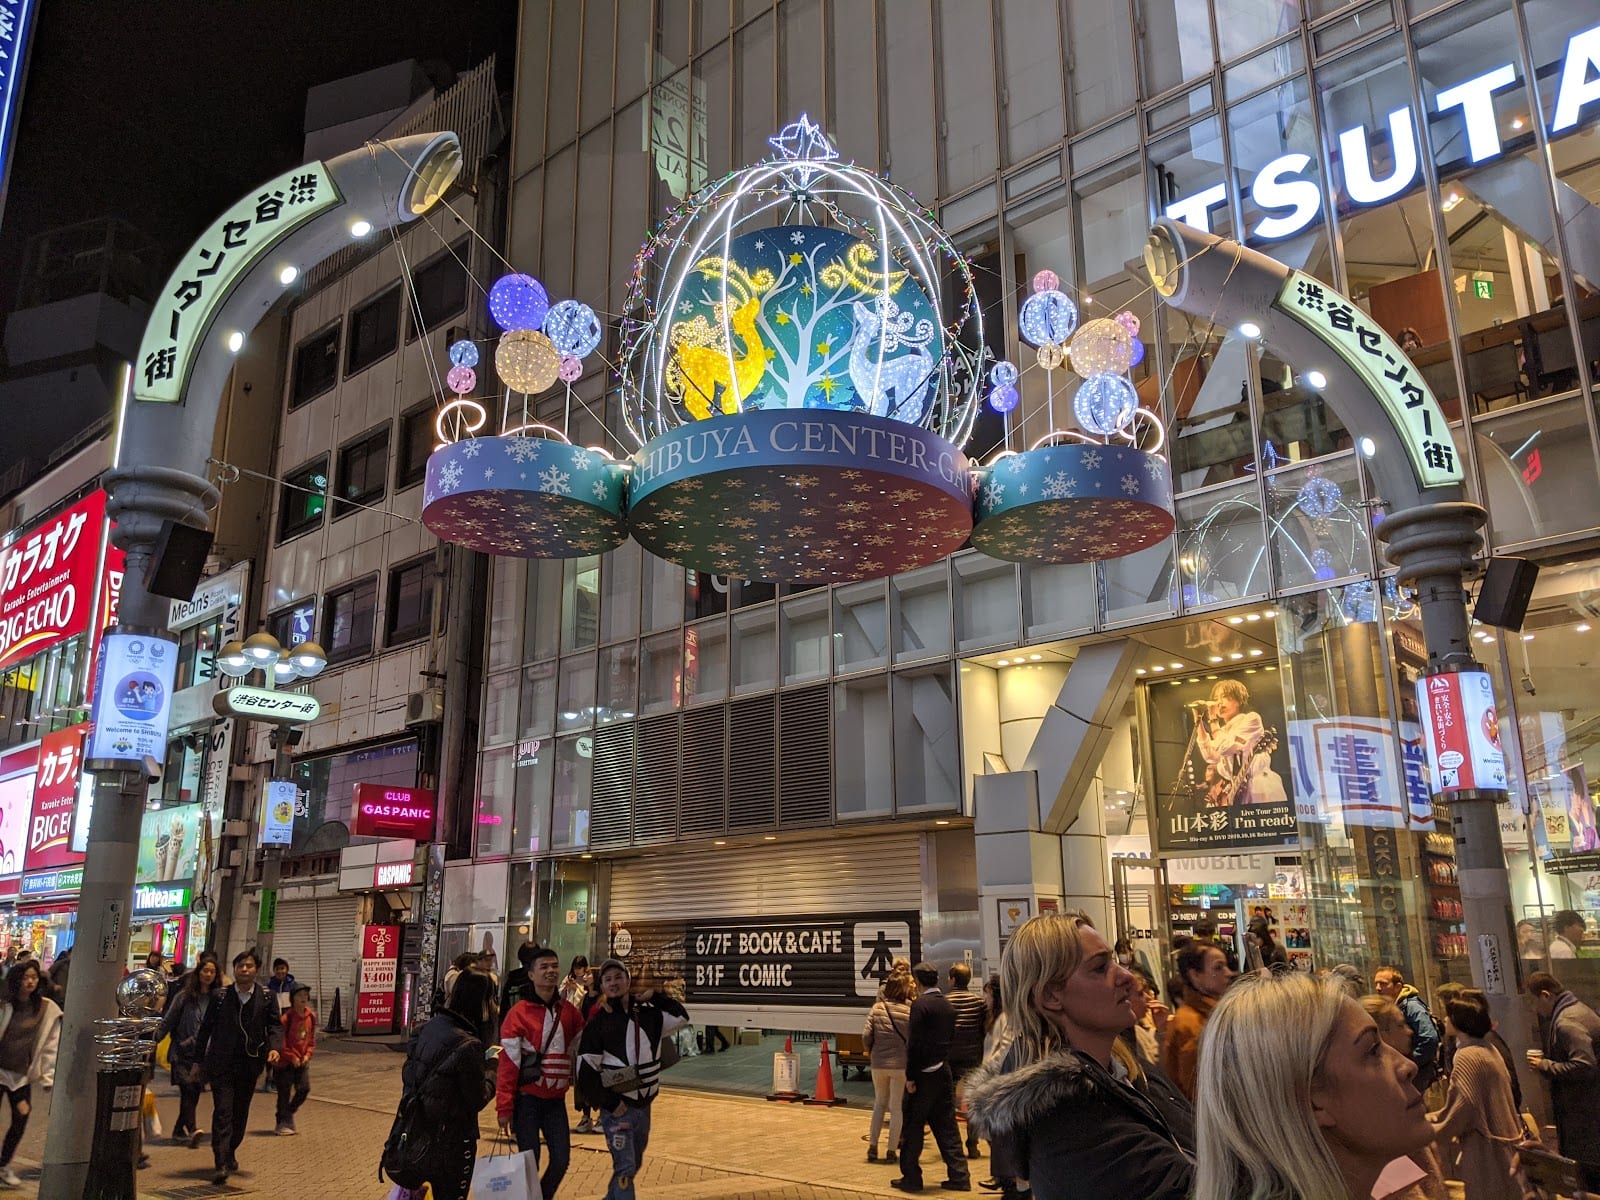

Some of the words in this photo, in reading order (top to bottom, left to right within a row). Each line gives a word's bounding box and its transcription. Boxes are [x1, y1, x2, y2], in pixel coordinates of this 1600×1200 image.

[144, 173, 318, 387] 渋谷センター街
[1297, 281, 1454, 472] 渋谷センター街
[633, 424, 759, 493] SHIBUYA
[0, 512, 87, 595] カラオケ
[4, 595, 25, 613] Karaoke
[27, 569, 70, 600] Entertainment
[24, 584, 76, 634] ECHO
[171, 592, 209, 623] Mean's
[233, 694, 316, 714] 渋谷センター街
[385, 792, 411, 802] CLUB
[1170, 811, 1229, 834] 山本彩
[1235, 817, 1256, 829] I'm
[1260, 814, 1296, 829] ready
[1241, 809, 1254, 817] Live
[1256, 808, 1271, 816] Tour
[31, 813, 60, 850] BIG
[371, 934, 392, 943] GAS
[695, 933, 732, 955] 6/7F
[860, 931, 903, 987] 本
[363, 972, 393, 982] ¥400
[695, 964, 725, 986] B1F
[739, 963, 792, 986] COMIC
[361, 1006, 391, 1014] ENTRANCE
